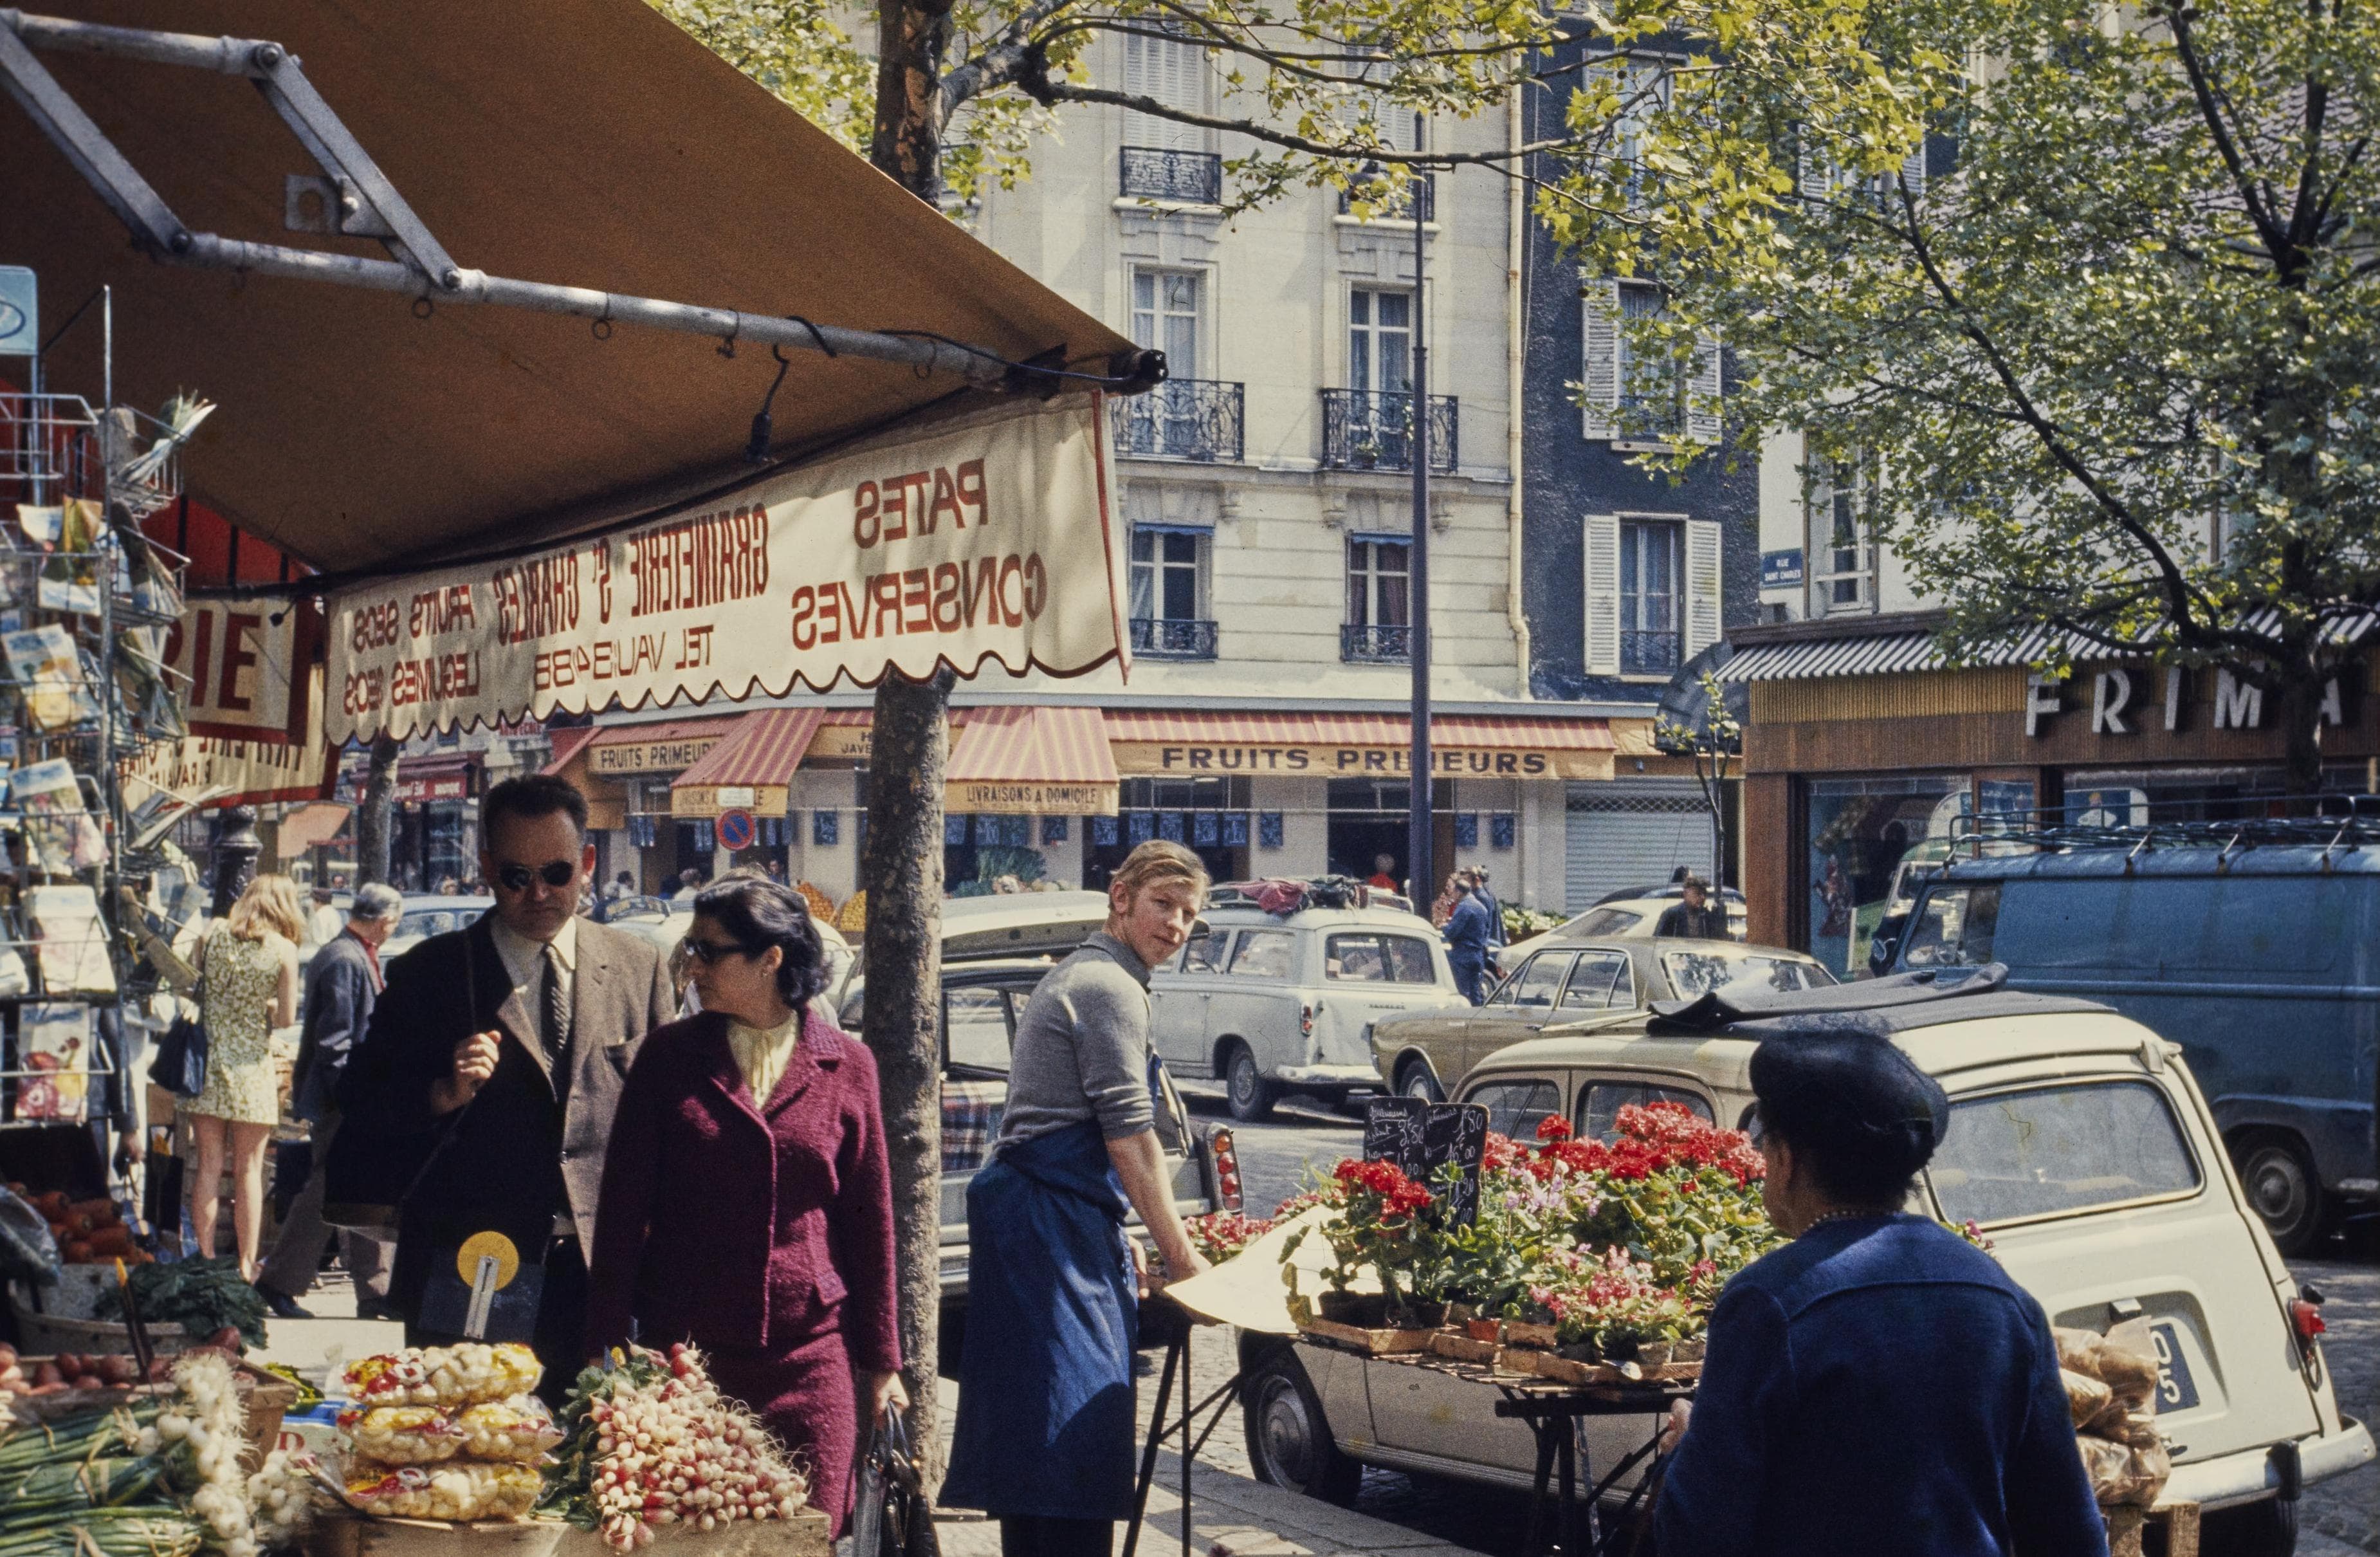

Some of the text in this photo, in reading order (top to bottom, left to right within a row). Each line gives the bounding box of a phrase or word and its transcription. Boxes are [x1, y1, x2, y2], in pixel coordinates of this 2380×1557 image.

[601, 747, 643, 769] FRUITS
[1162, 747, 1310, 769] FRUITS
[966, 786, 1030, 803] LIVRAISONS
[1046, 787, 1097, 804] DOMICILE
